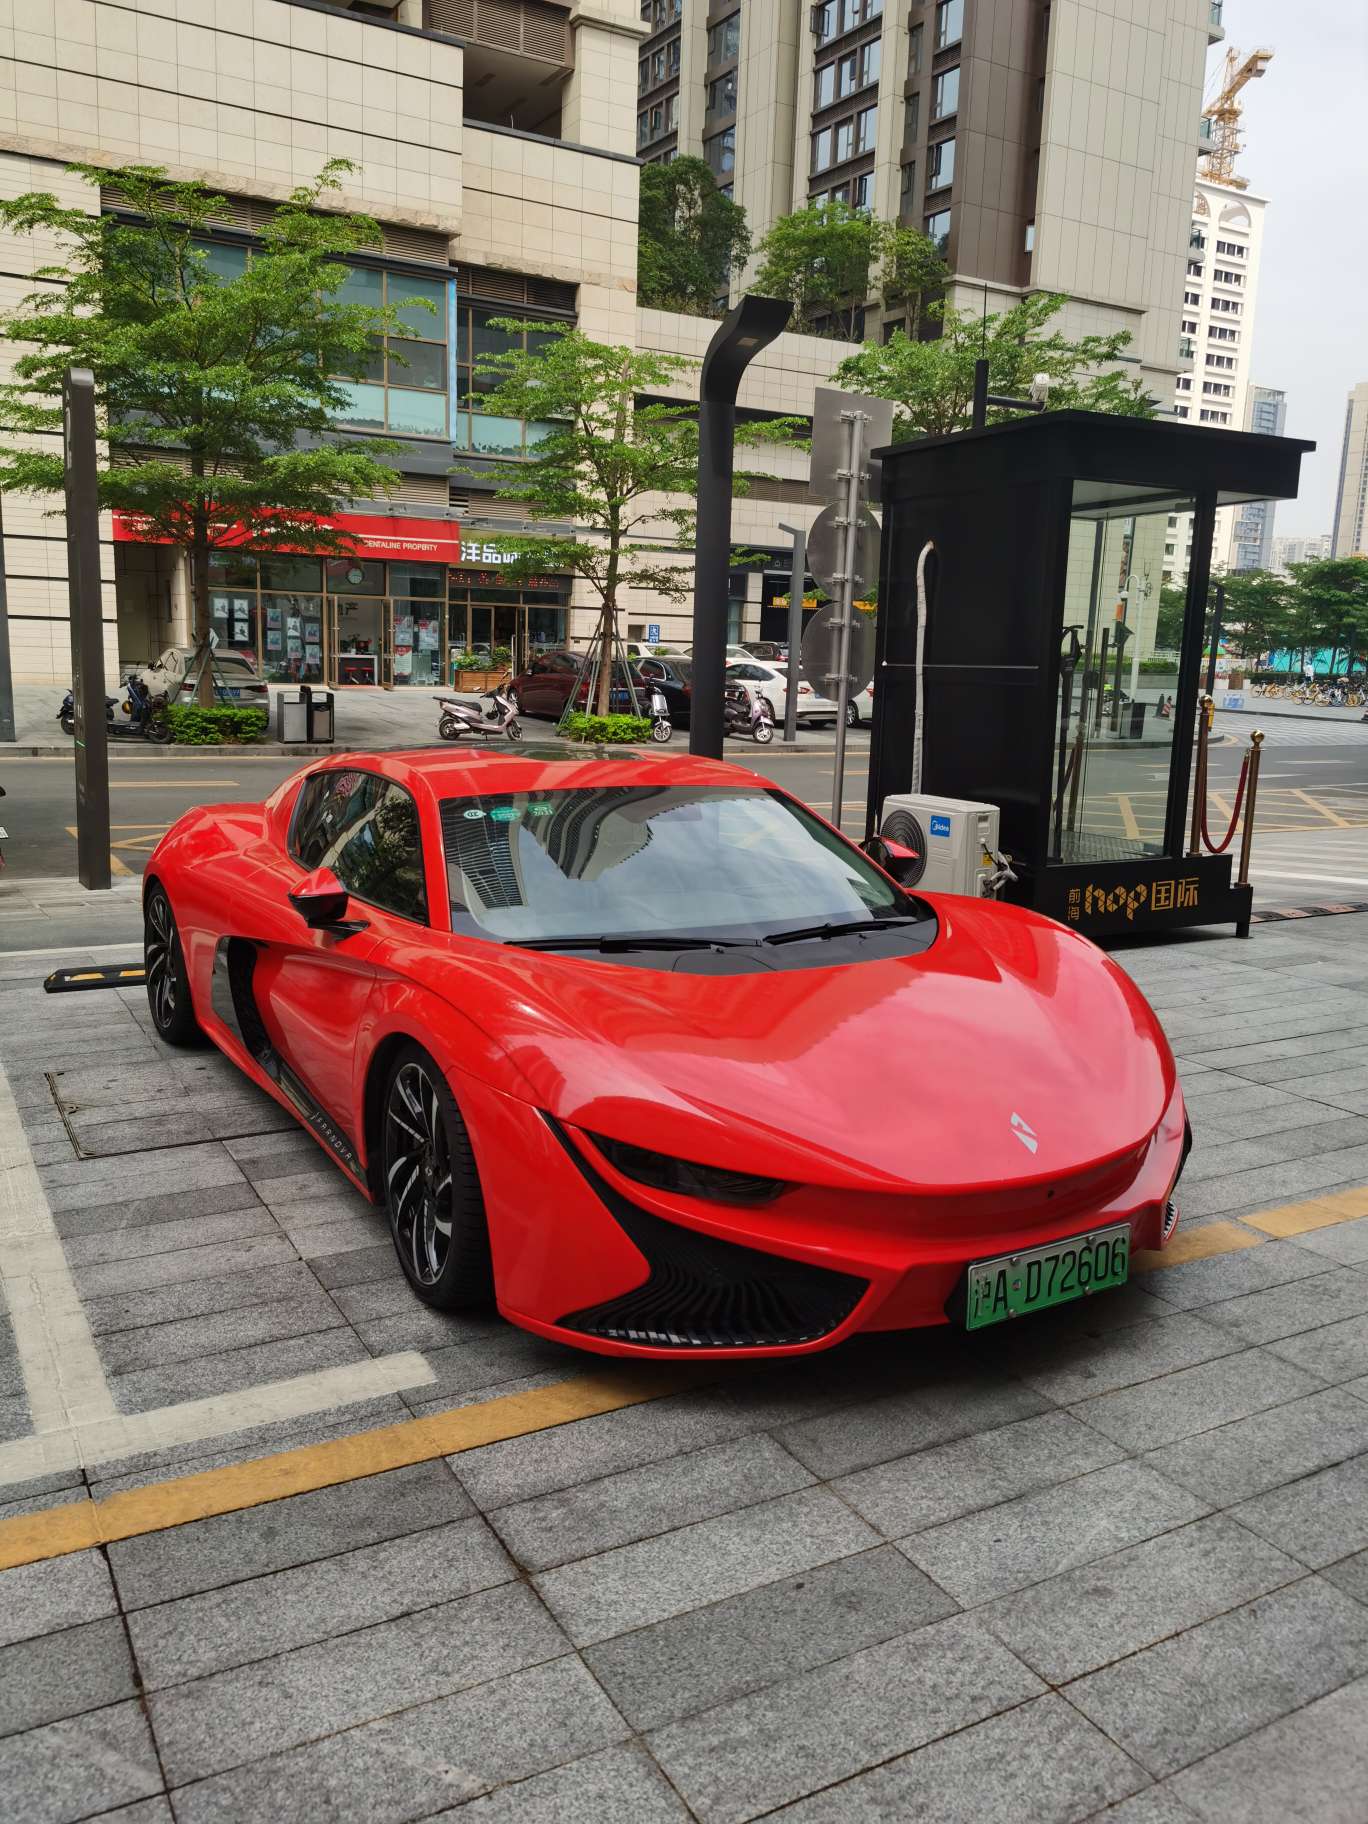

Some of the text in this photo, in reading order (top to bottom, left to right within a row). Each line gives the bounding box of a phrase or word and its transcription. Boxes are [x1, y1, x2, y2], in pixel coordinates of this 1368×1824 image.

[403, 542, 438, 552] PROPERTY
[1085, 877, 1199, 920] hop 国际
[1024, 1237, 1126, 1303] D72606
